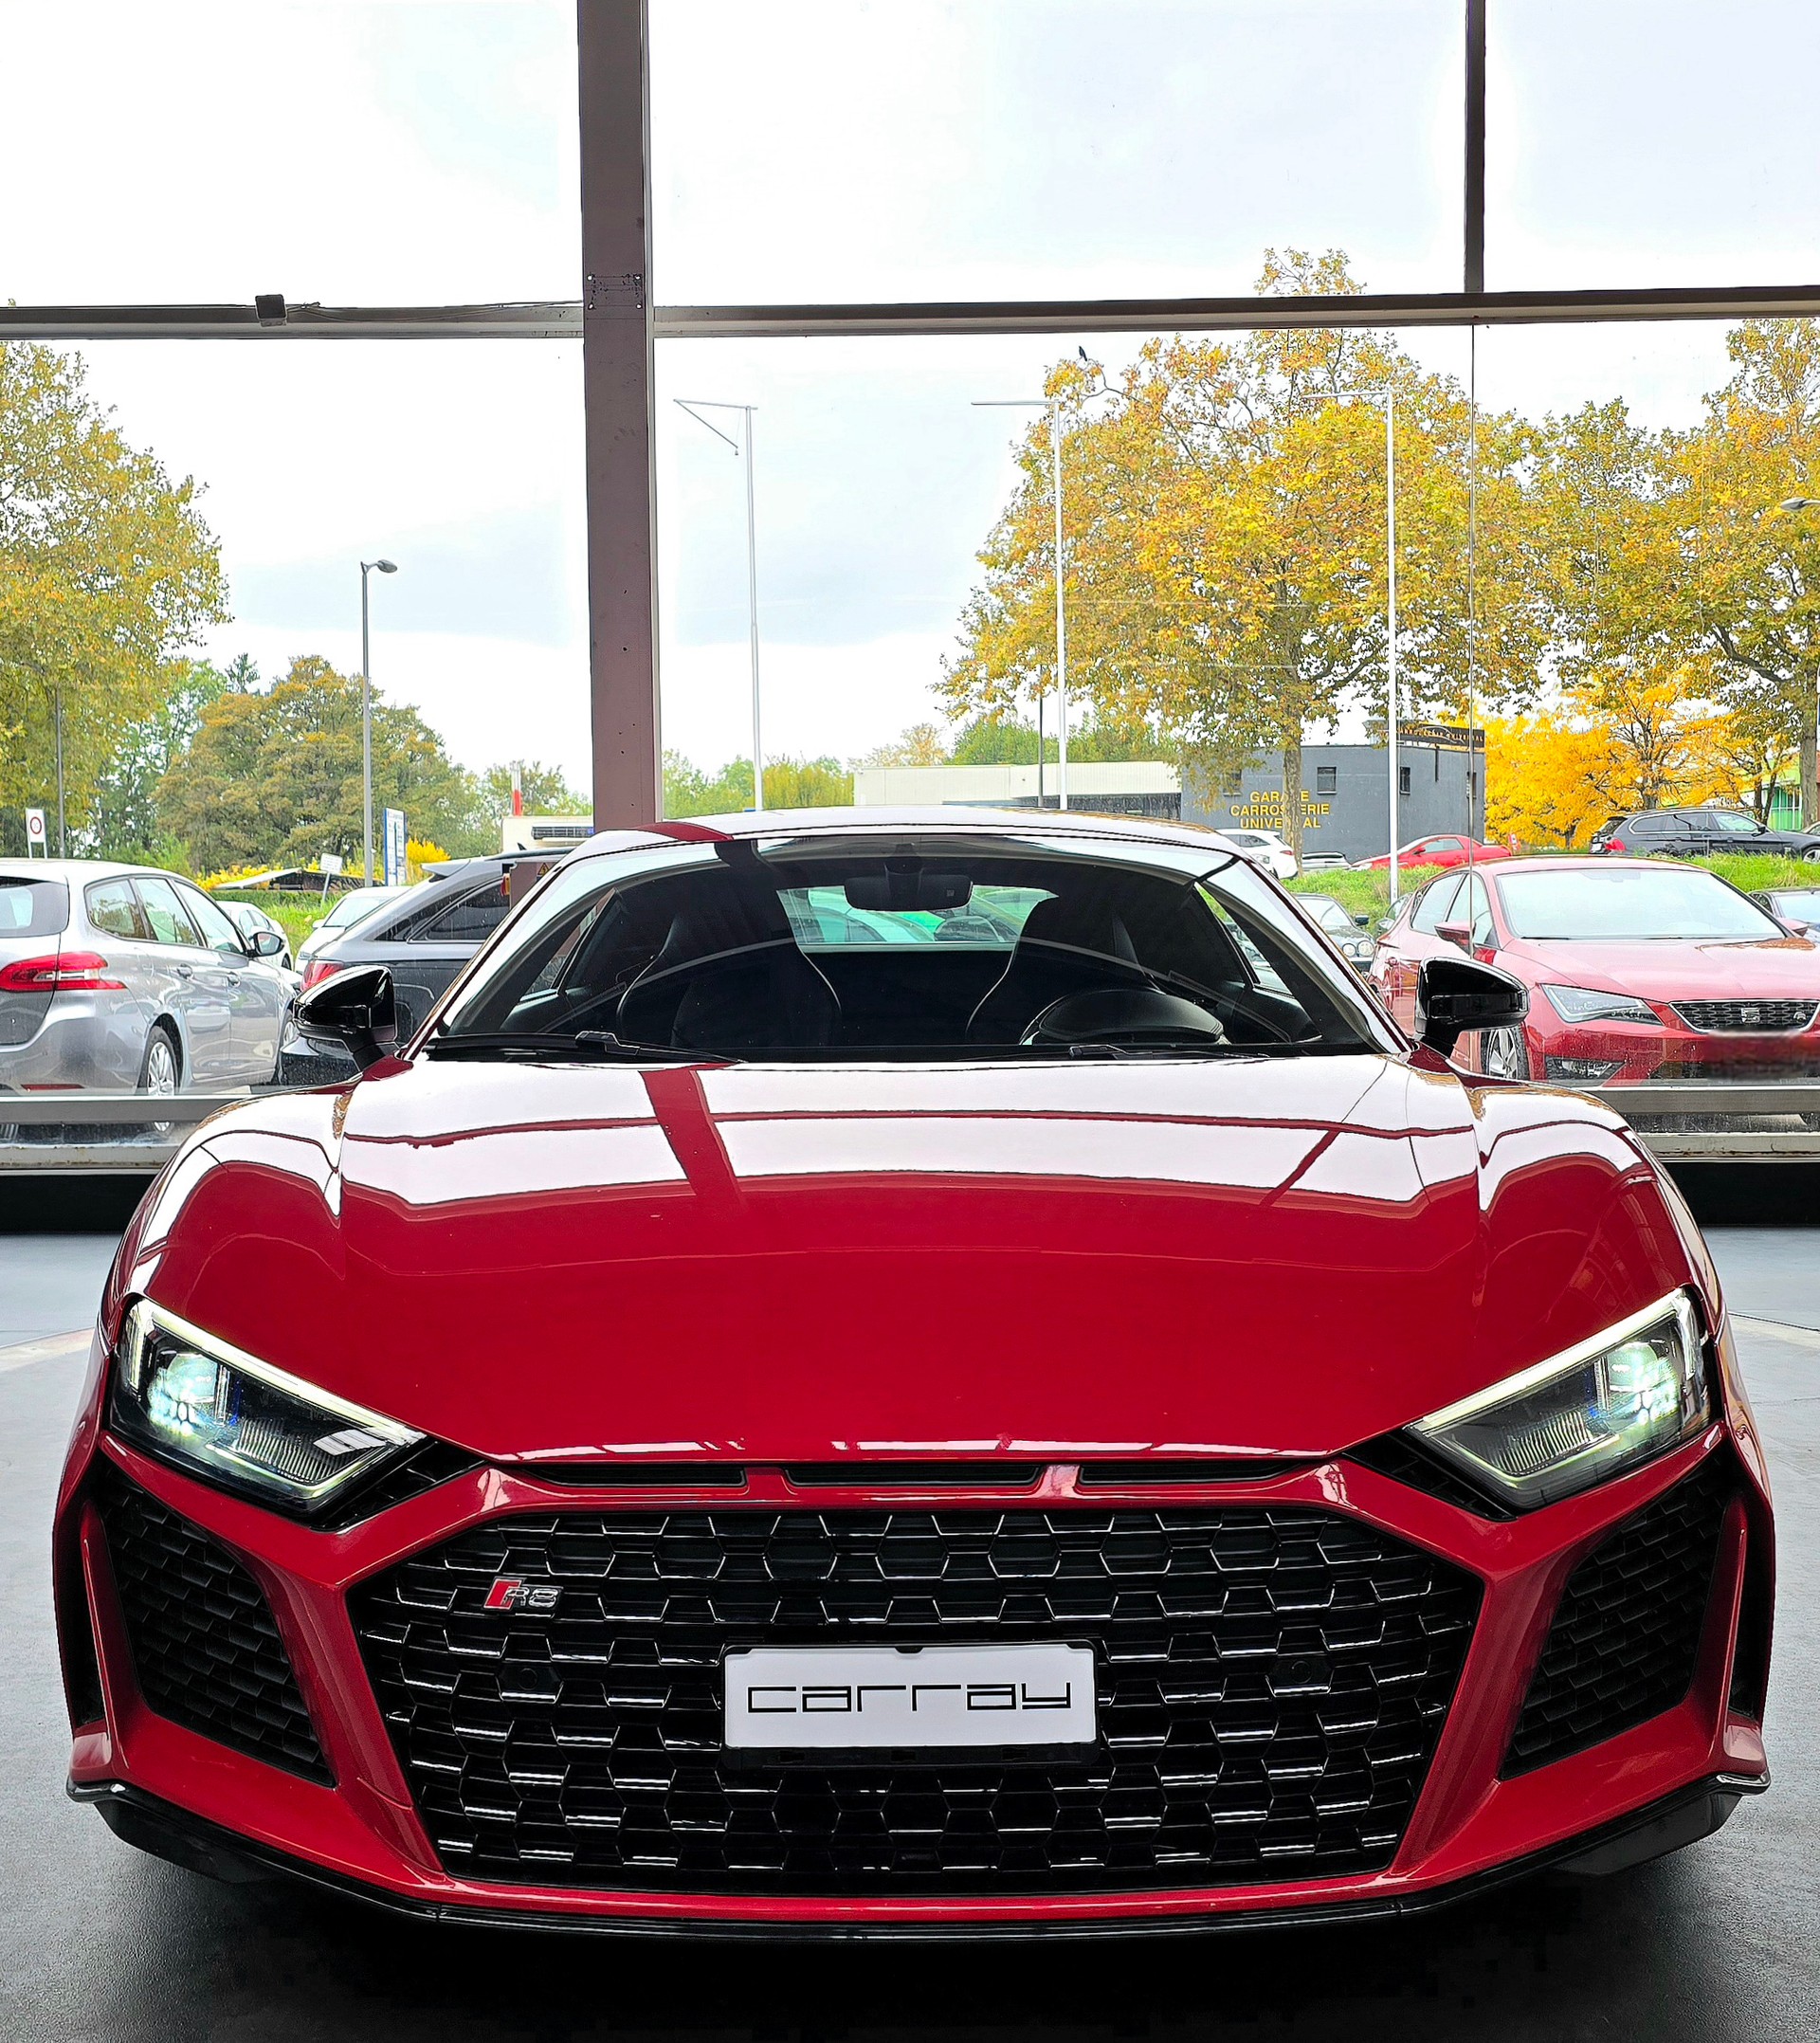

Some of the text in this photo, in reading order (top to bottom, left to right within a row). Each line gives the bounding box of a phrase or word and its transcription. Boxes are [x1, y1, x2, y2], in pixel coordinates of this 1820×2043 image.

[1249, 790, 1310, 803] GARE
[1240, 816, 1320, 829] UNIVEAL
[494, 1584, 558, 1608] R8
[747, 1682, 1071, 1713] carray
